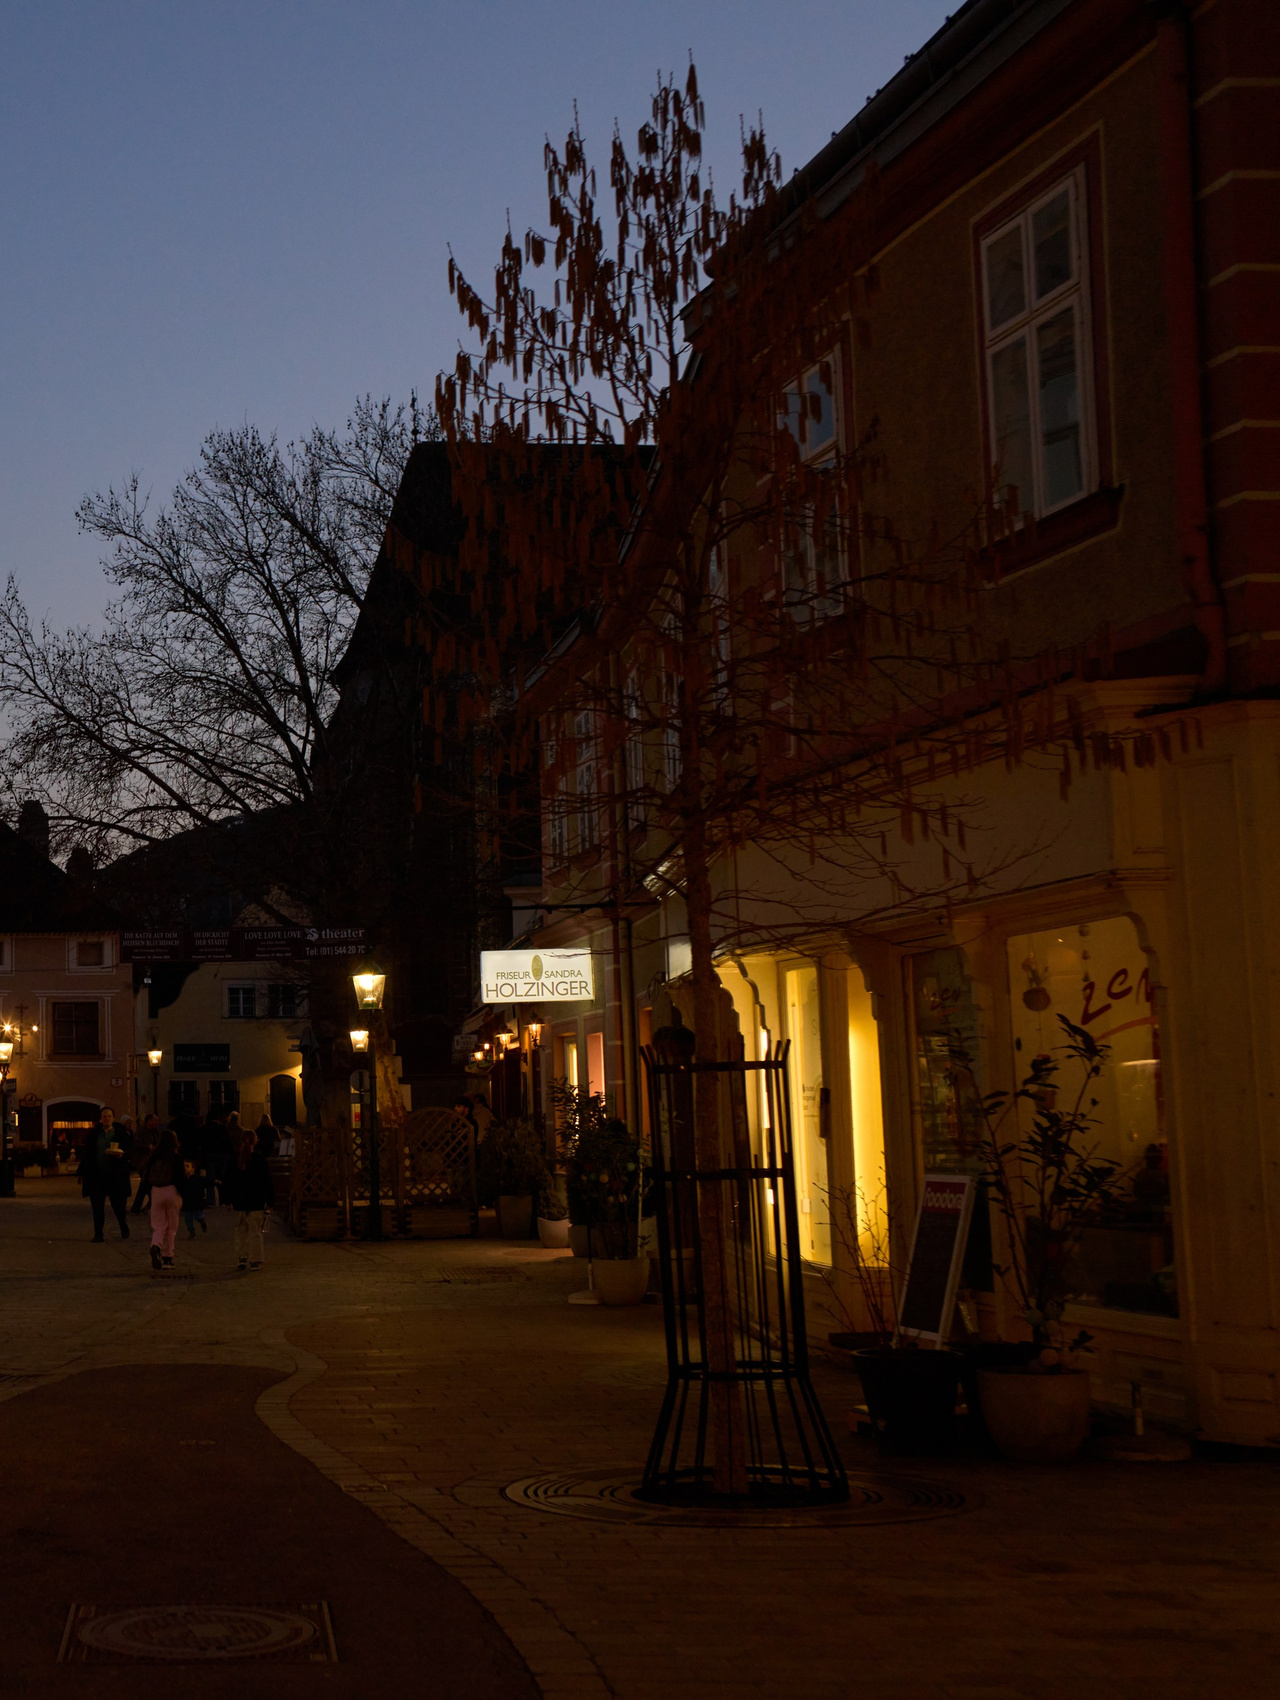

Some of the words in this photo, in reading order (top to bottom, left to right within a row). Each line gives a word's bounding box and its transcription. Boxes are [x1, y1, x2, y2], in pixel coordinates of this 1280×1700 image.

[244, 932, 263, 940] LOVE
[264, 931, 283, 939] LOVE
[284, 930, 302, 939] LOVE
[322, 928, 365, 939] theater
[320, 946, 333, 956] (01)
[334, 945, 347, 955] 544
[348, 945, 356, 954] 20
[496, 971, 531, 980] FRISEUR
[544, 970, 583, 979] SANDRA
[485, 980, 591, 998] HOLZINGER
